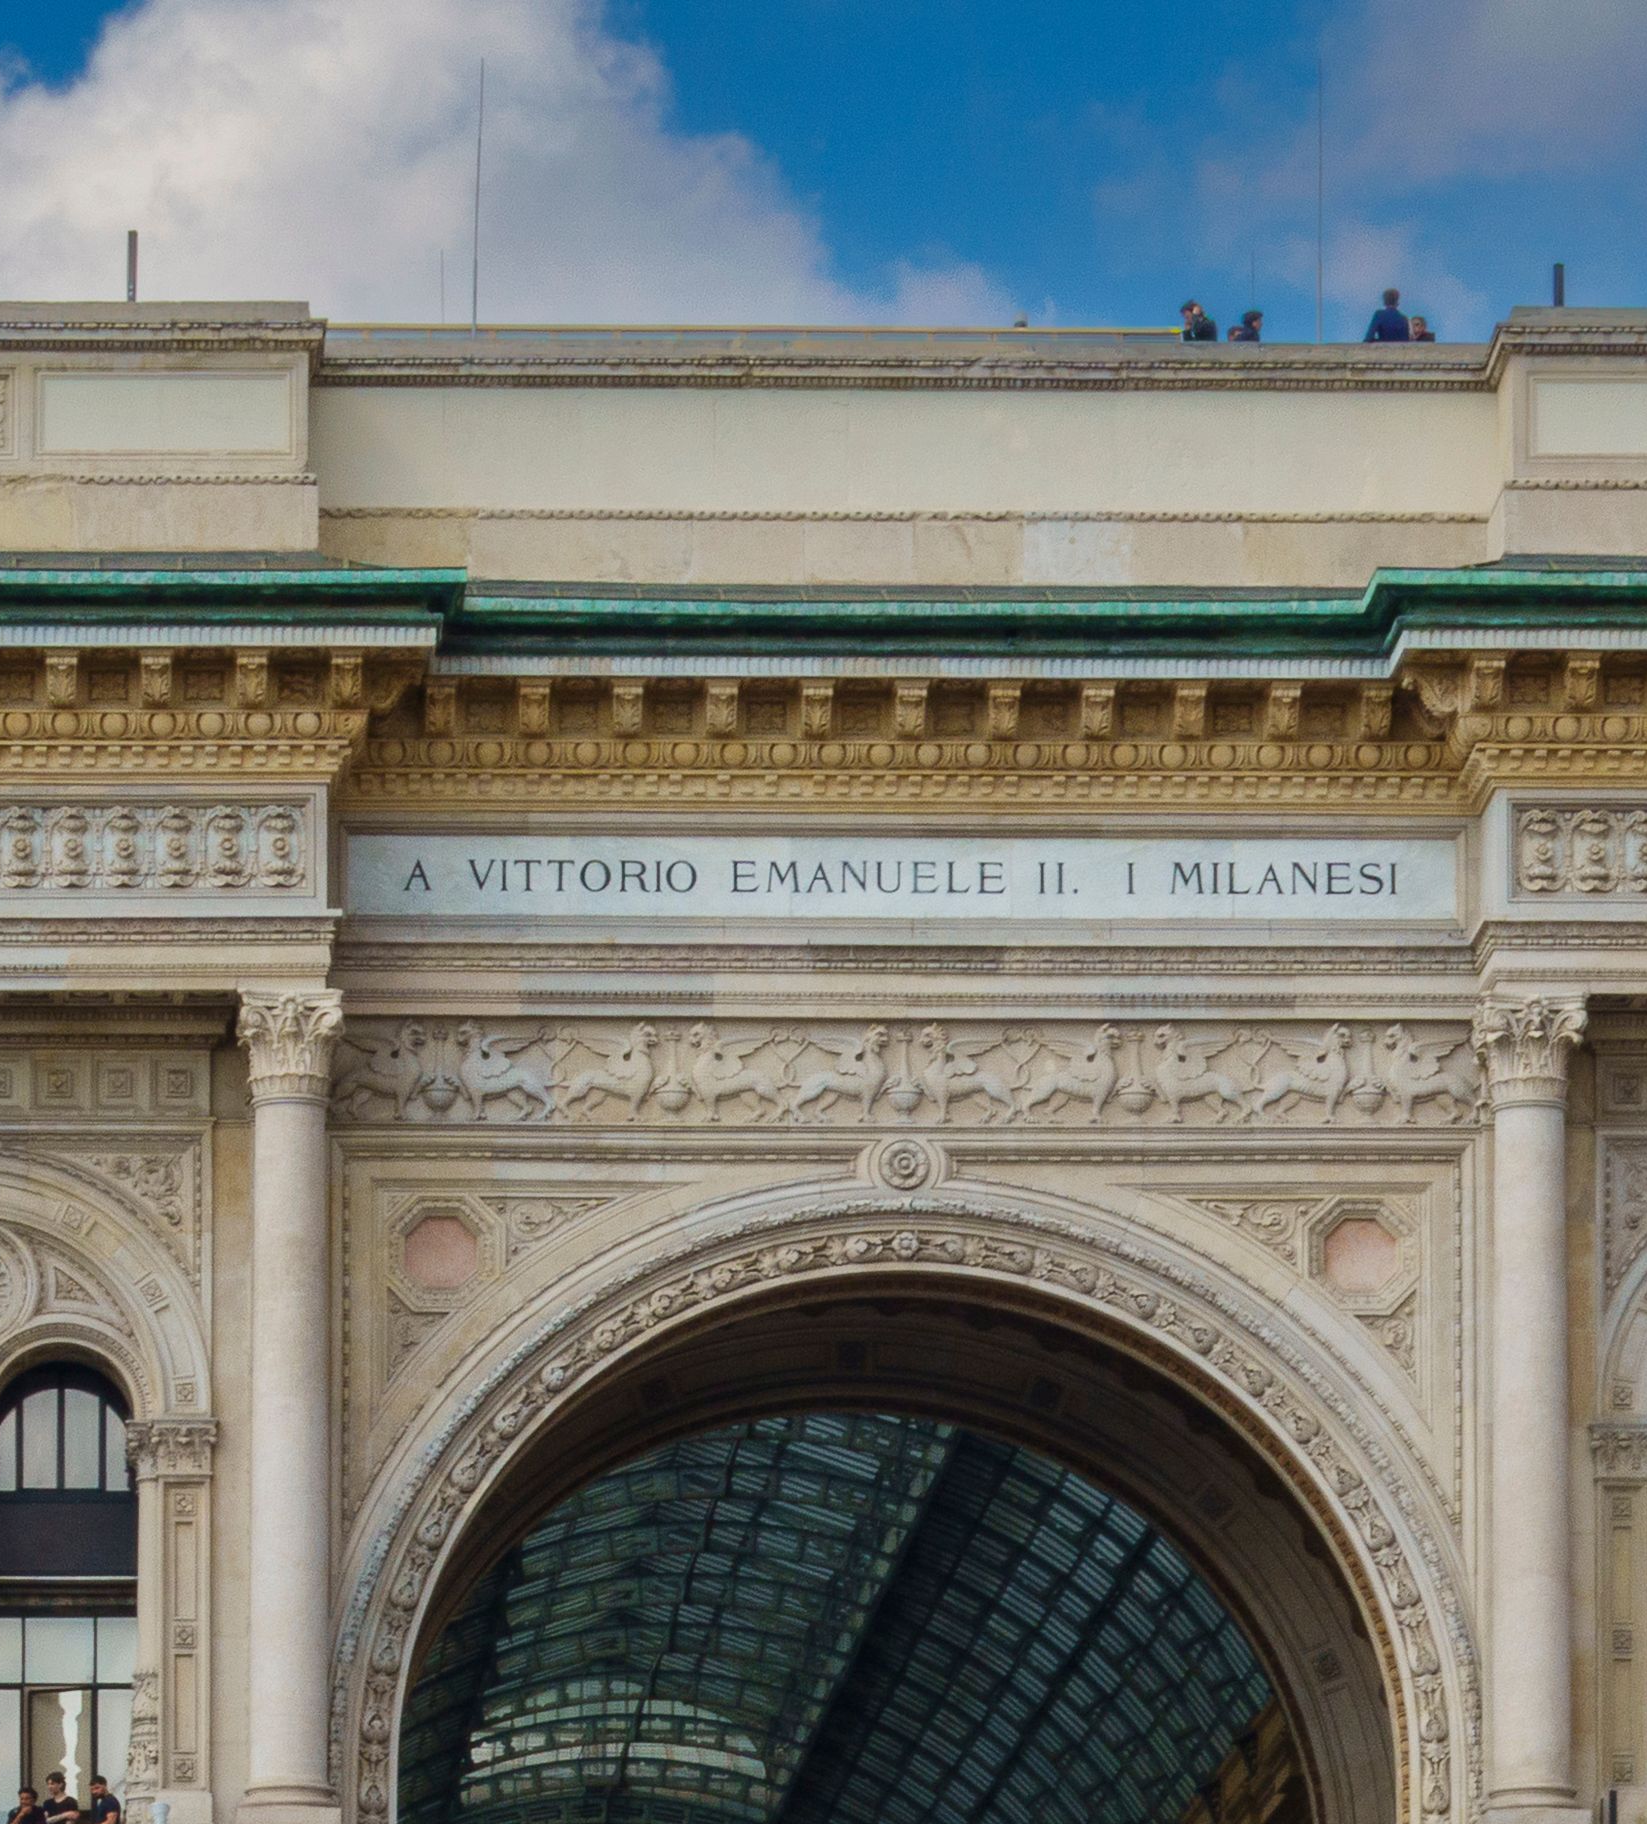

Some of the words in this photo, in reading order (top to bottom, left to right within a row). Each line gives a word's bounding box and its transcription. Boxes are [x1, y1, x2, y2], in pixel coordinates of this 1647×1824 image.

[403, 859, 433, 892] A
[468, 859, 697, 892] VITTORIO
[731, 860, 1006, 893] EMANUELE
[1126, 862, 1135, 893] I
[1170, 862, 1398, 894] MILANESI
